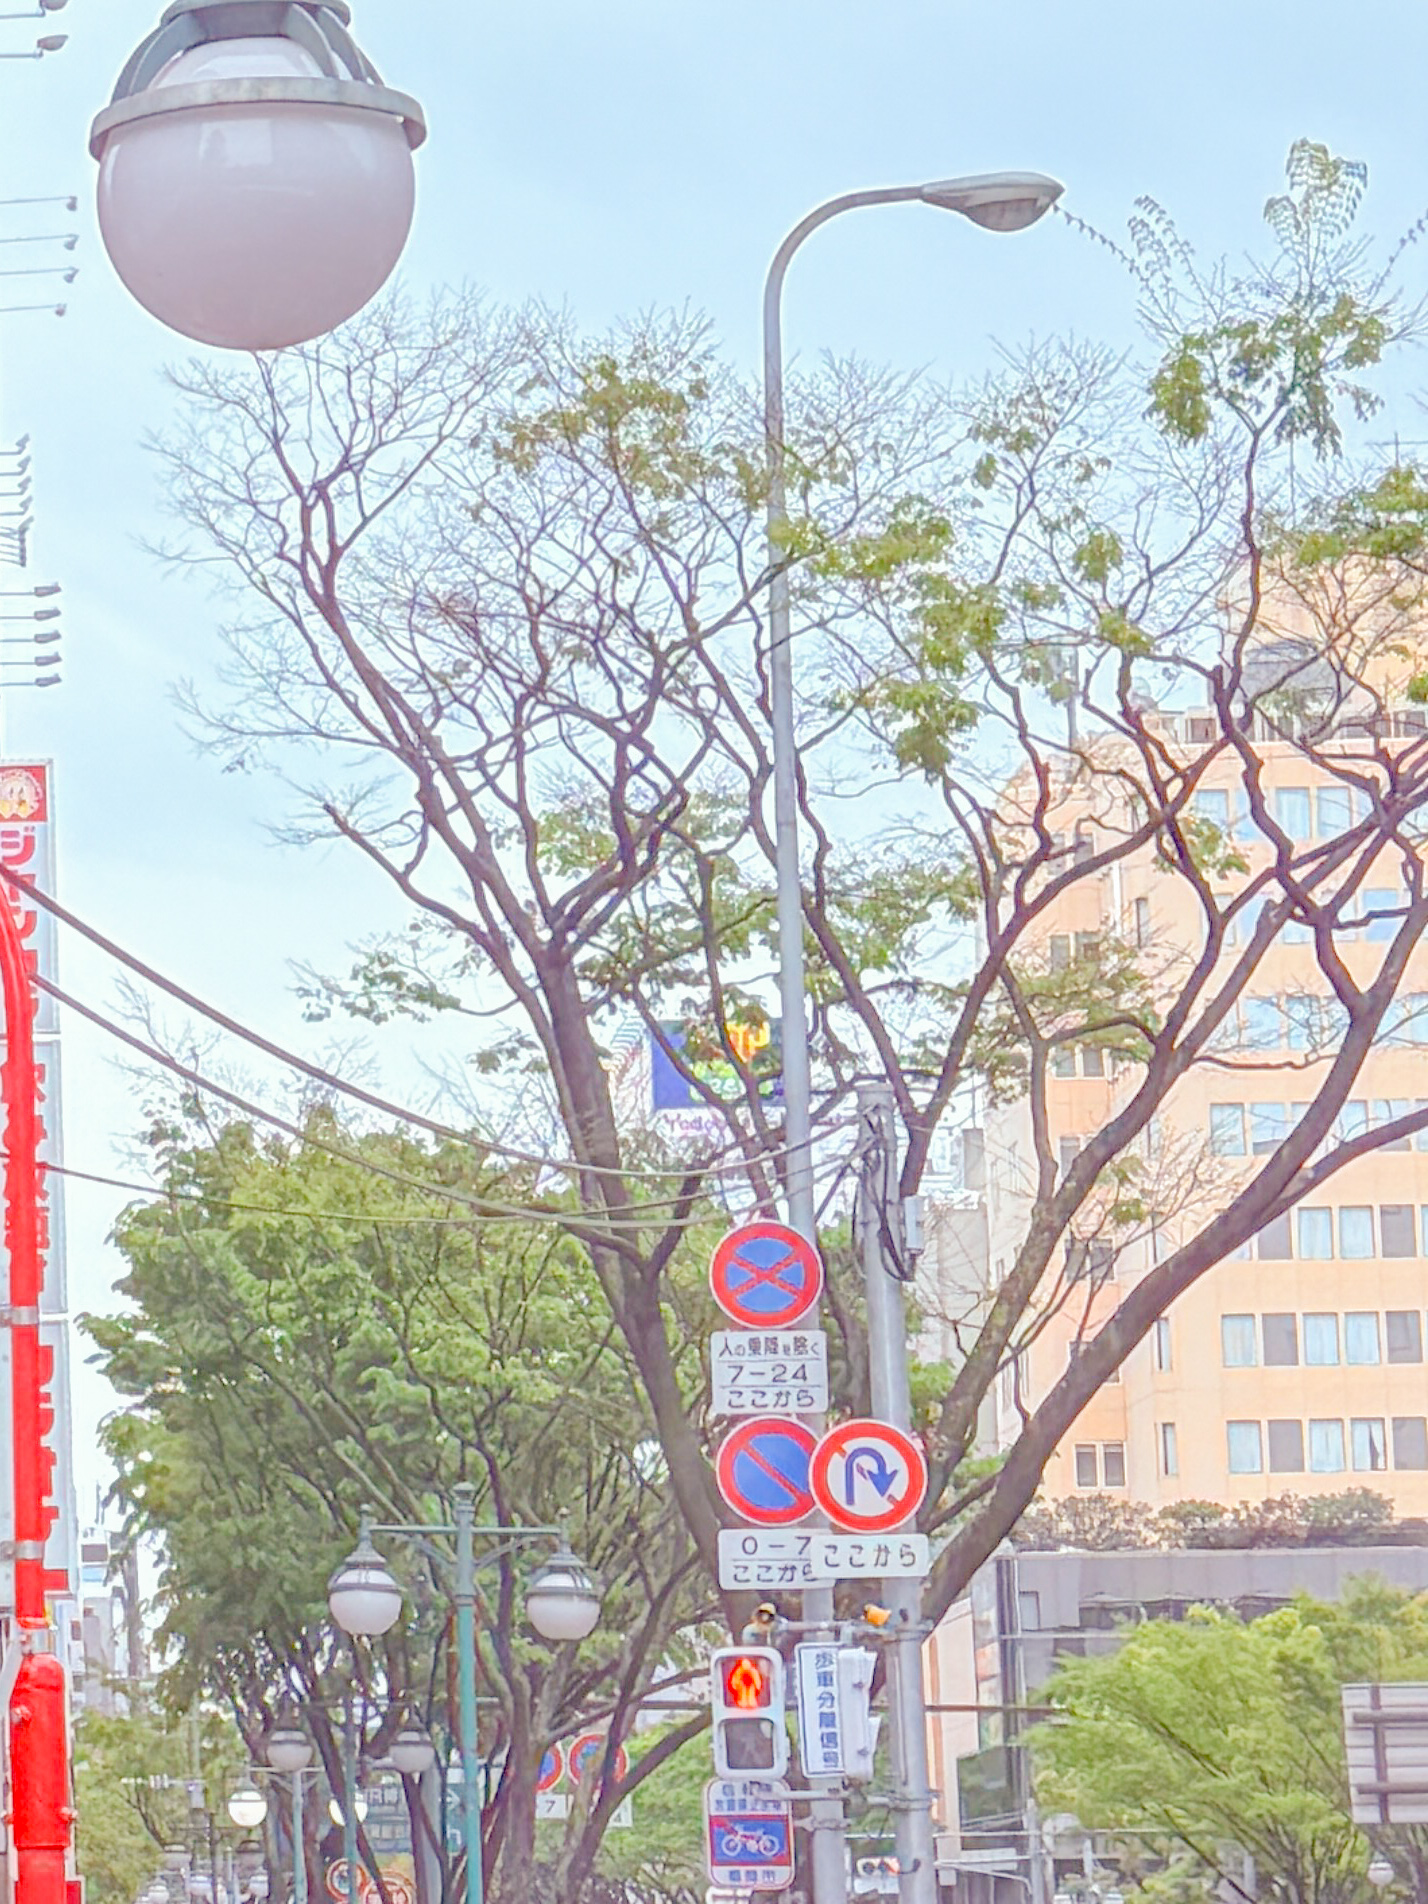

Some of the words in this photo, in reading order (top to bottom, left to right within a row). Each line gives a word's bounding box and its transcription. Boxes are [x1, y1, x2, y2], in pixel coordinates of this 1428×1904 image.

[727, 1389, 815, 1408] ここから
[823, 1543, 917, 1569] ここから
[814, 1651, 840, 1769] 歩車分離信号
